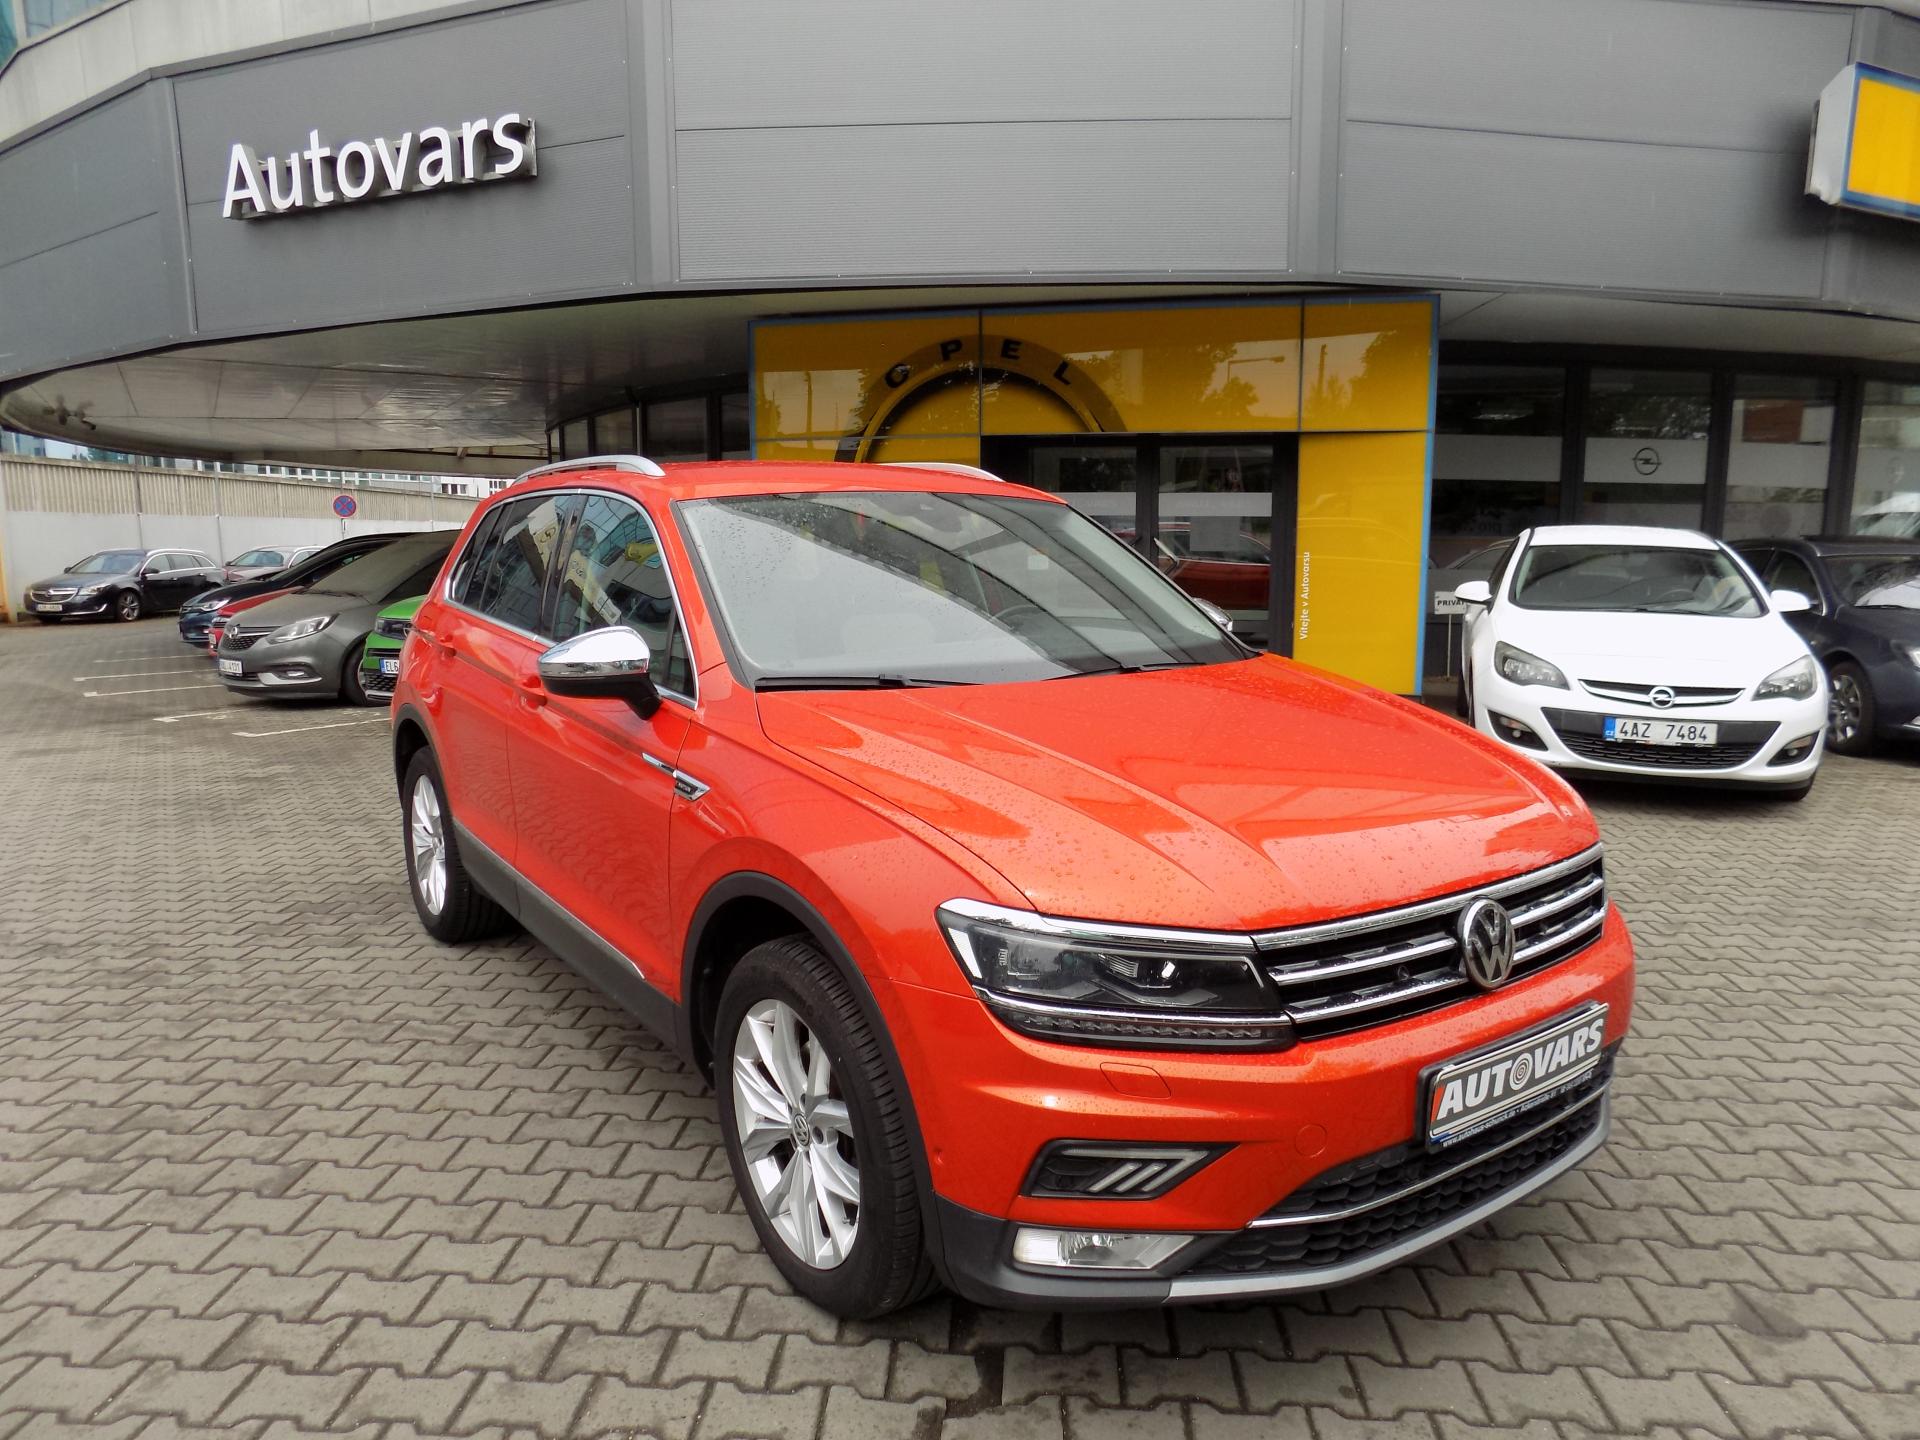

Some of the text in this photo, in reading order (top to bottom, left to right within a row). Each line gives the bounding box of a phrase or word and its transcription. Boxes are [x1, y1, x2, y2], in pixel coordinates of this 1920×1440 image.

[222, 113, 527, 218] Autovars
[1300, 551, 1310, 599] Autovarsu
[1619, 721, 1707, 741] 4AZ 7484
[1436, 1018, 1604, 1121] AUTOVARS
